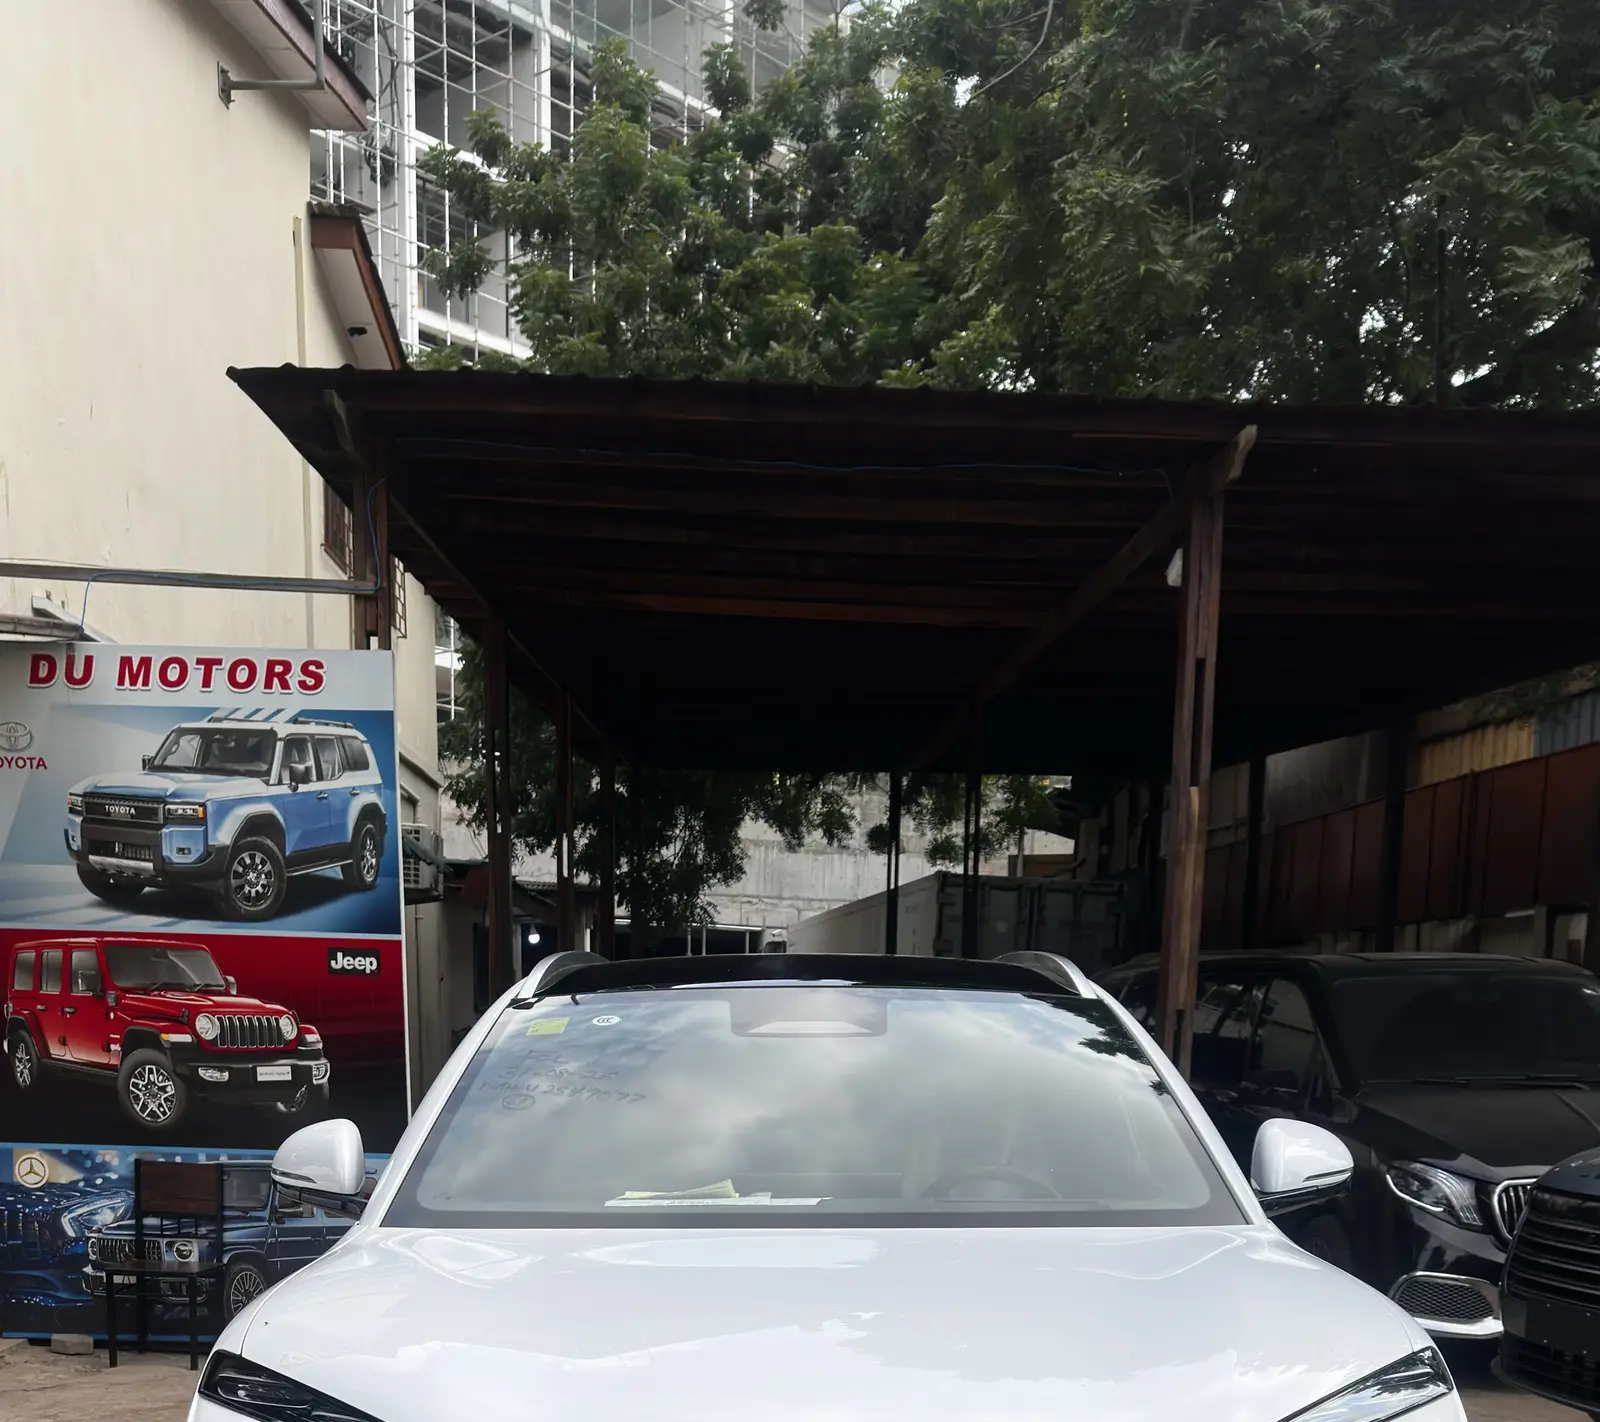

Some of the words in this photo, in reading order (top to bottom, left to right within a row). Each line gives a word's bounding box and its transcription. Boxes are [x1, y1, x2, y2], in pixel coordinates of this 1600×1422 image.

[27, 653, 96, 688] DU
[116, 654, 327, 695] MOTORS
[104, 804, 136, 815] TOYOTA
[330, 951, 378, 974] Jeep
